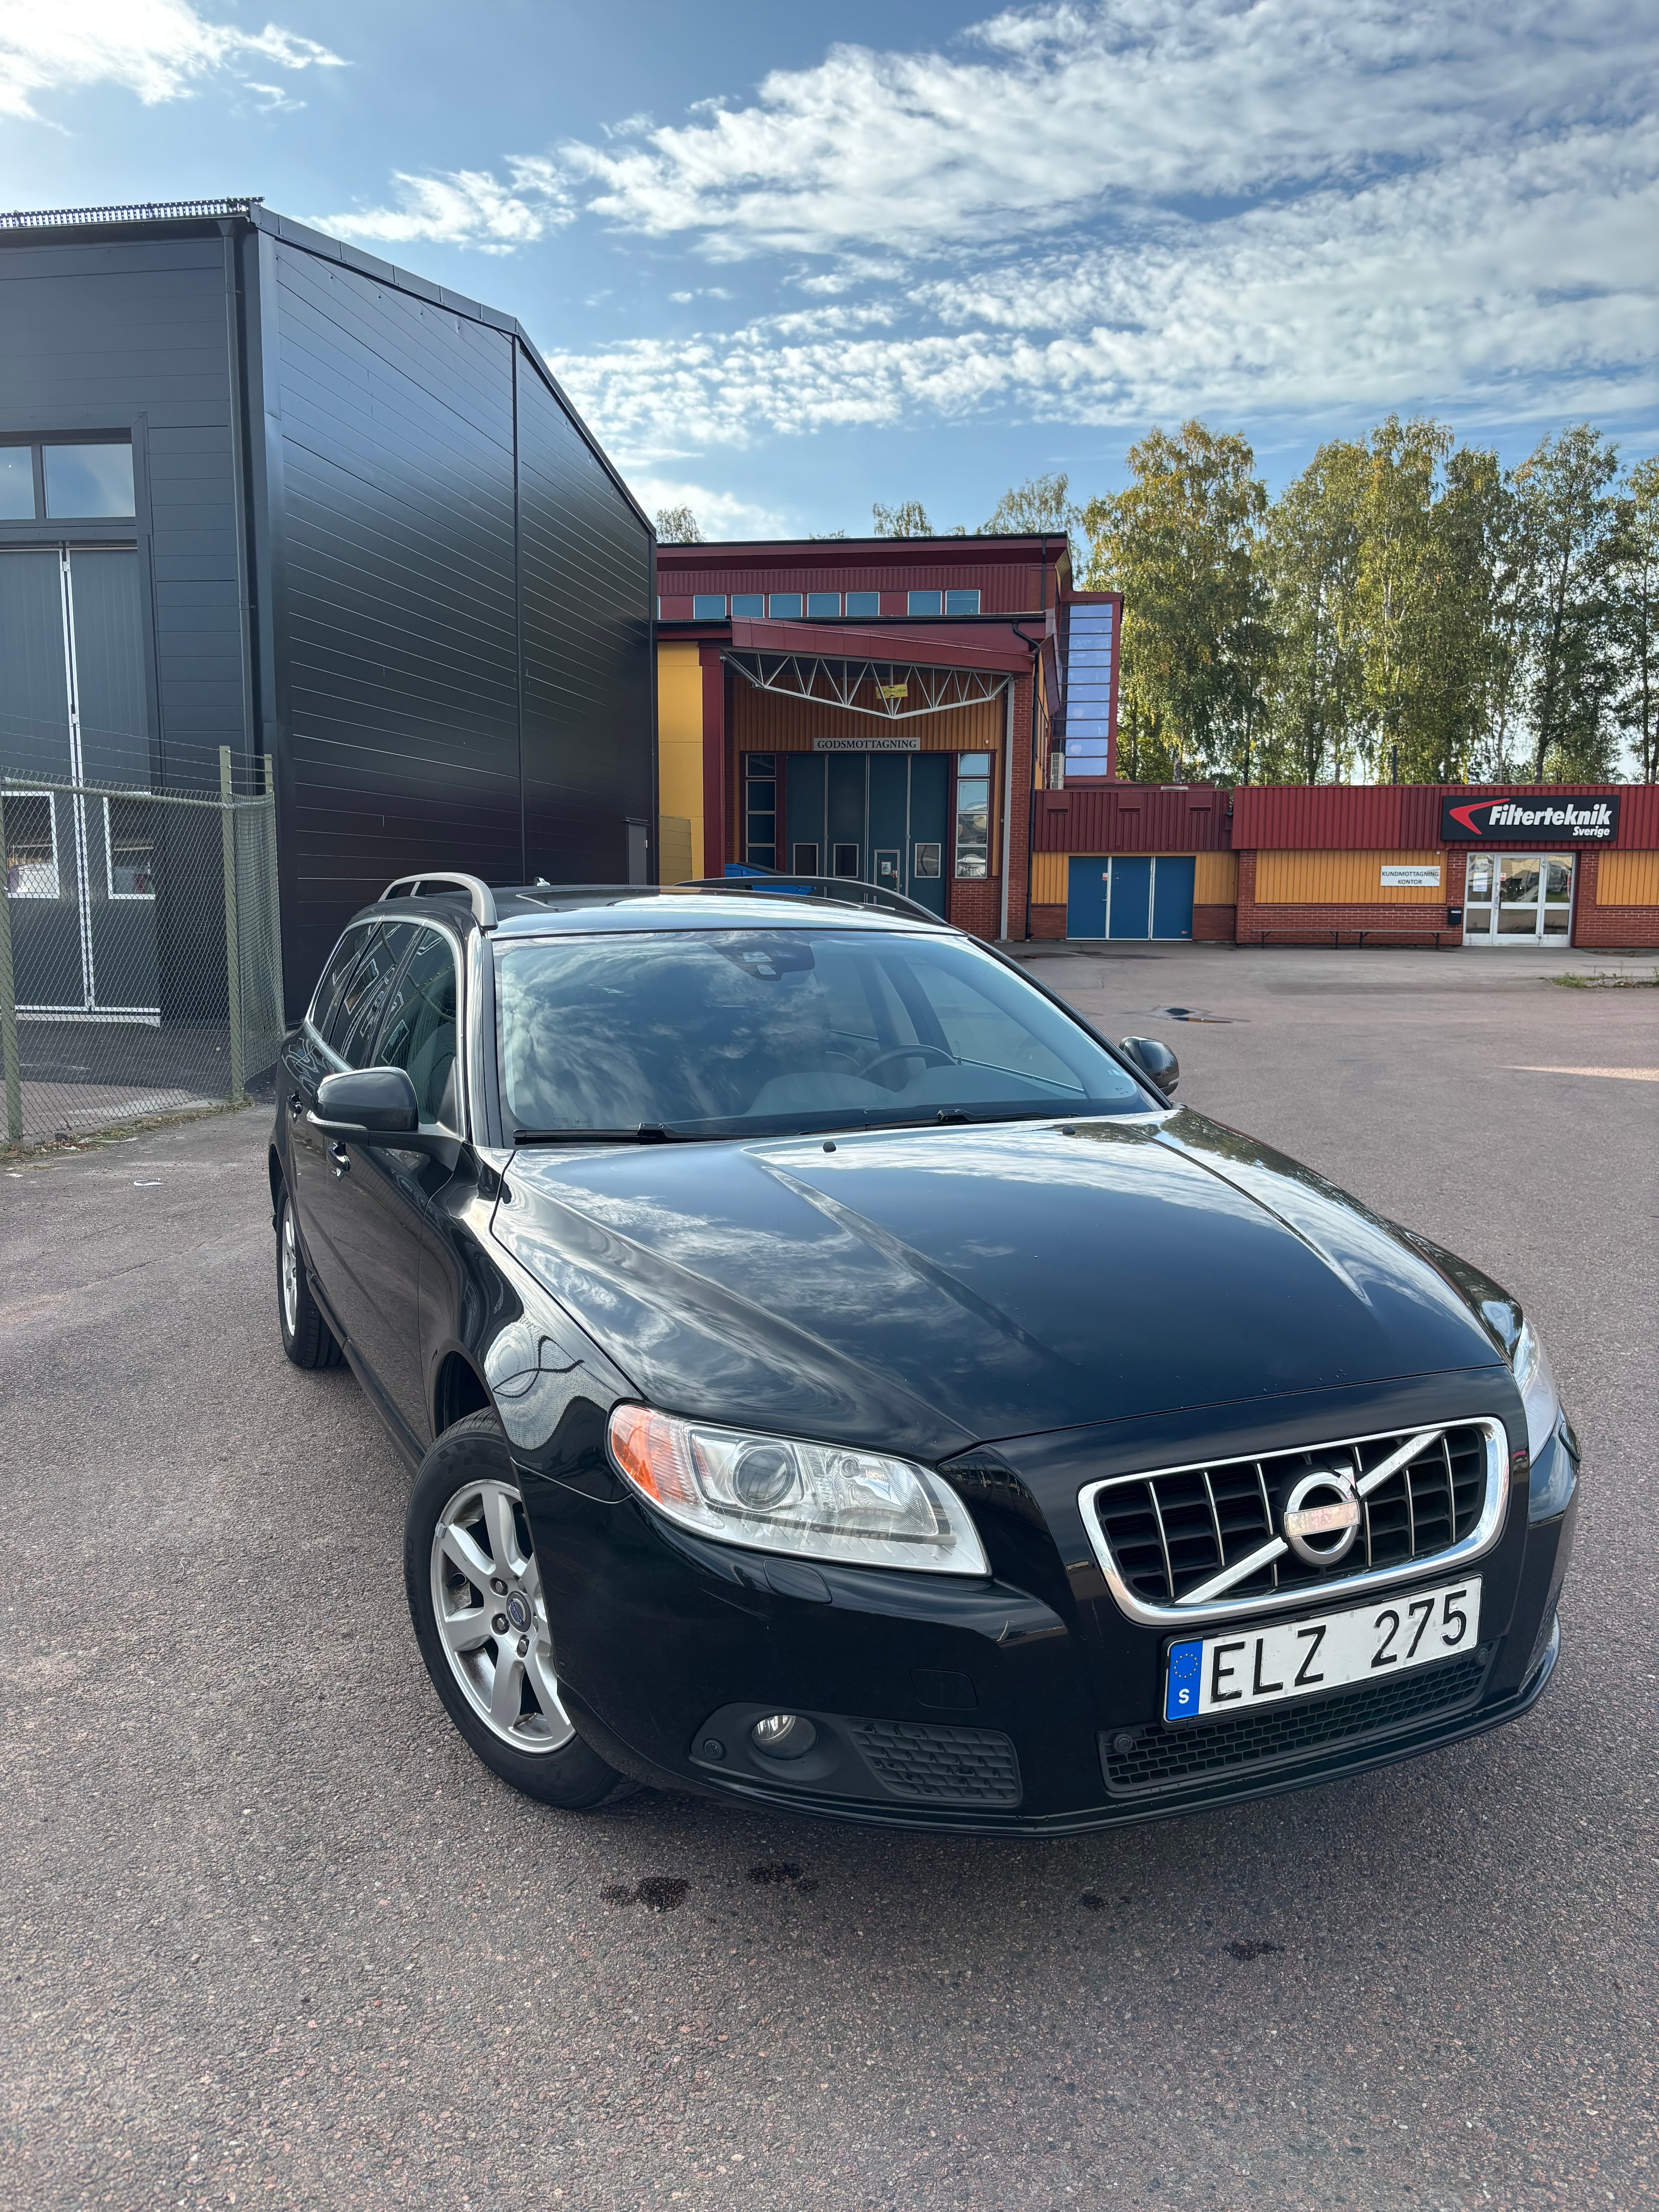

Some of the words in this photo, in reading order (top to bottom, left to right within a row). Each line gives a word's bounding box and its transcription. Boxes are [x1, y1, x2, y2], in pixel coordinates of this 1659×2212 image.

[817, 740, 916, 749] GODSMOTTAGNING
[1489, 804, 1613, 826] Filterteknik
[1572, 826, 1610, 838] Sverige
[406, 1535, 422, 1635] KUMHO
[511, 1601, 523, 1624] VOLVO
[1211, 1625, 1326, 1704] ELZ
[1371, 1590, 1467, 1668] 275
[1178, 1688, 1190, 1704] S
